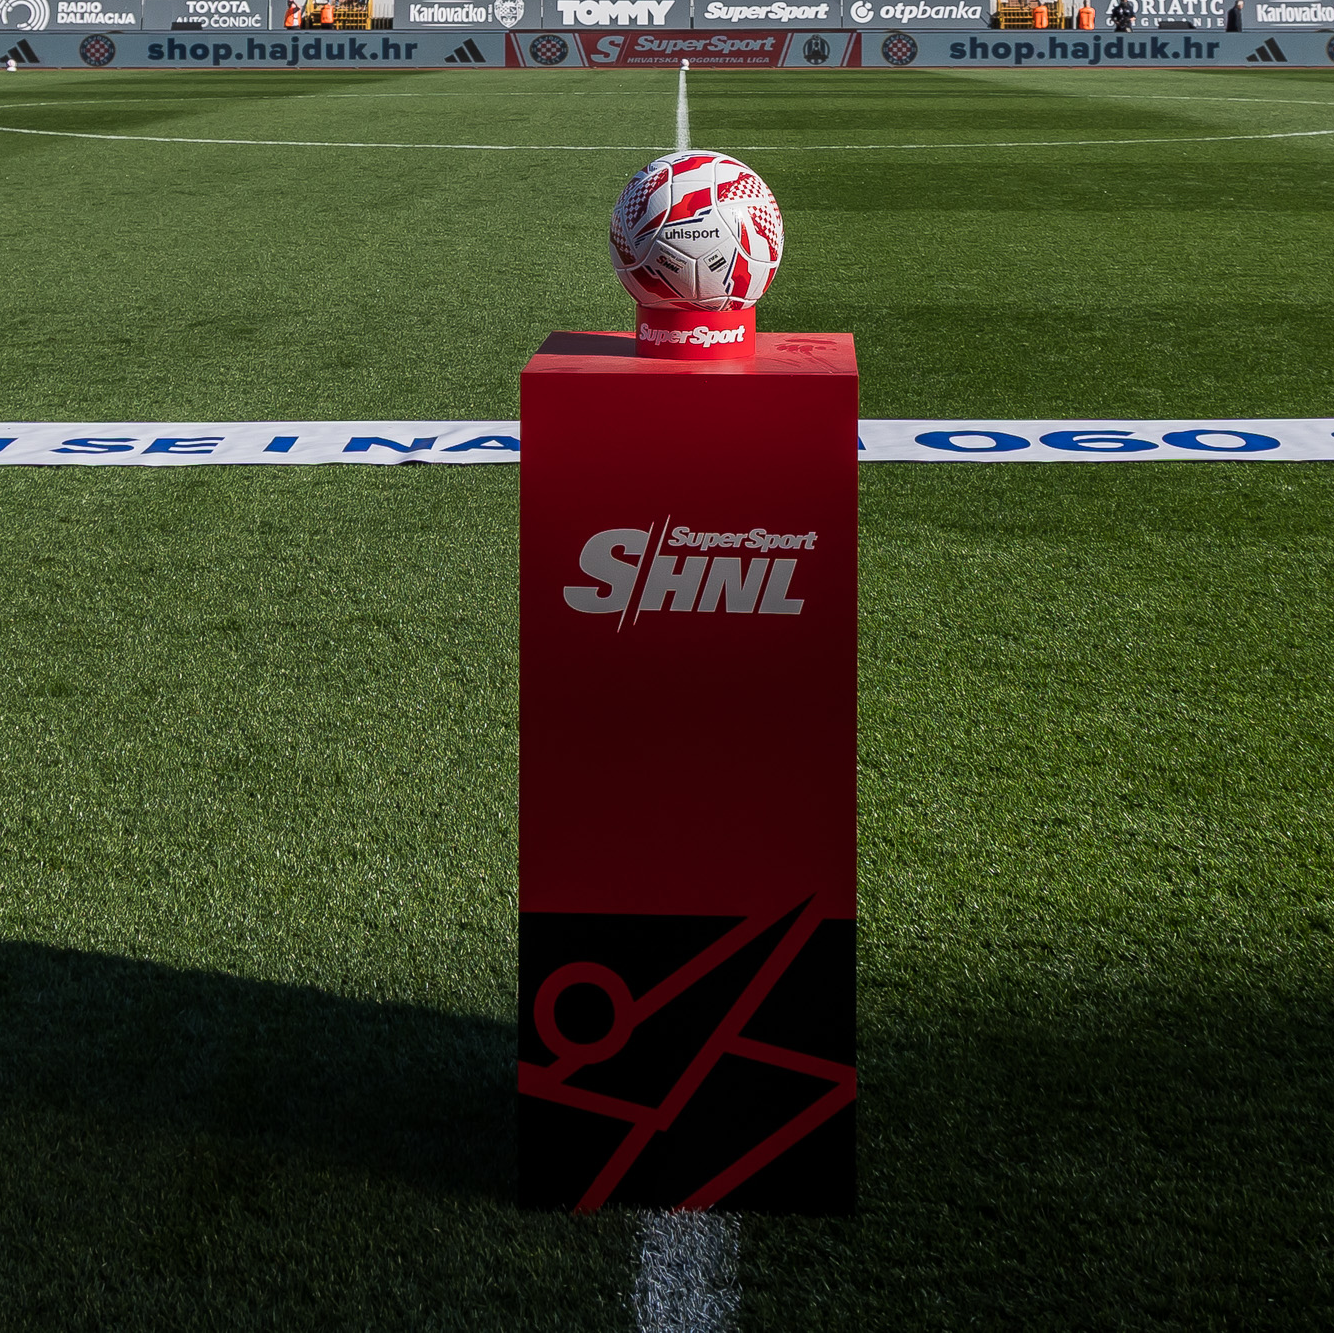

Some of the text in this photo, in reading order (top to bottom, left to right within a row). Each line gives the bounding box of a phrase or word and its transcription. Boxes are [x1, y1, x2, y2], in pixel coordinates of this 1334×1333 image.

[57, 1, 102, 13] RADIO
[186, 1, 251, 13] TOYOTA
[409, 3, 487, 23] Karlovačko
[557, 0, 675, 26] TOMMY
[703, 2, 830, 23] SuperSport
[879, 1, 982, 24] otpbanka
[57, 13, 136, 25] DALMACIJA
[210, 13, 262, 27] ČONDIĆ
[147, 37, 417, 66] shop.hajduk.hr
[634, 35, 776, 54] SuperSport
[949, 35, 1220, 64] shop.hajduk.hr
[665, 228, 720, 241] uhlsport
[639, 323, 746, 348] SuperSport
[50, 435, 226, 454] SE
[262, 436, 291, 454] I
[914, 428, 1281, 453] 060
[667, 526, 818, 553] SuperSport
[563, 528, 805, 615] SHNL
